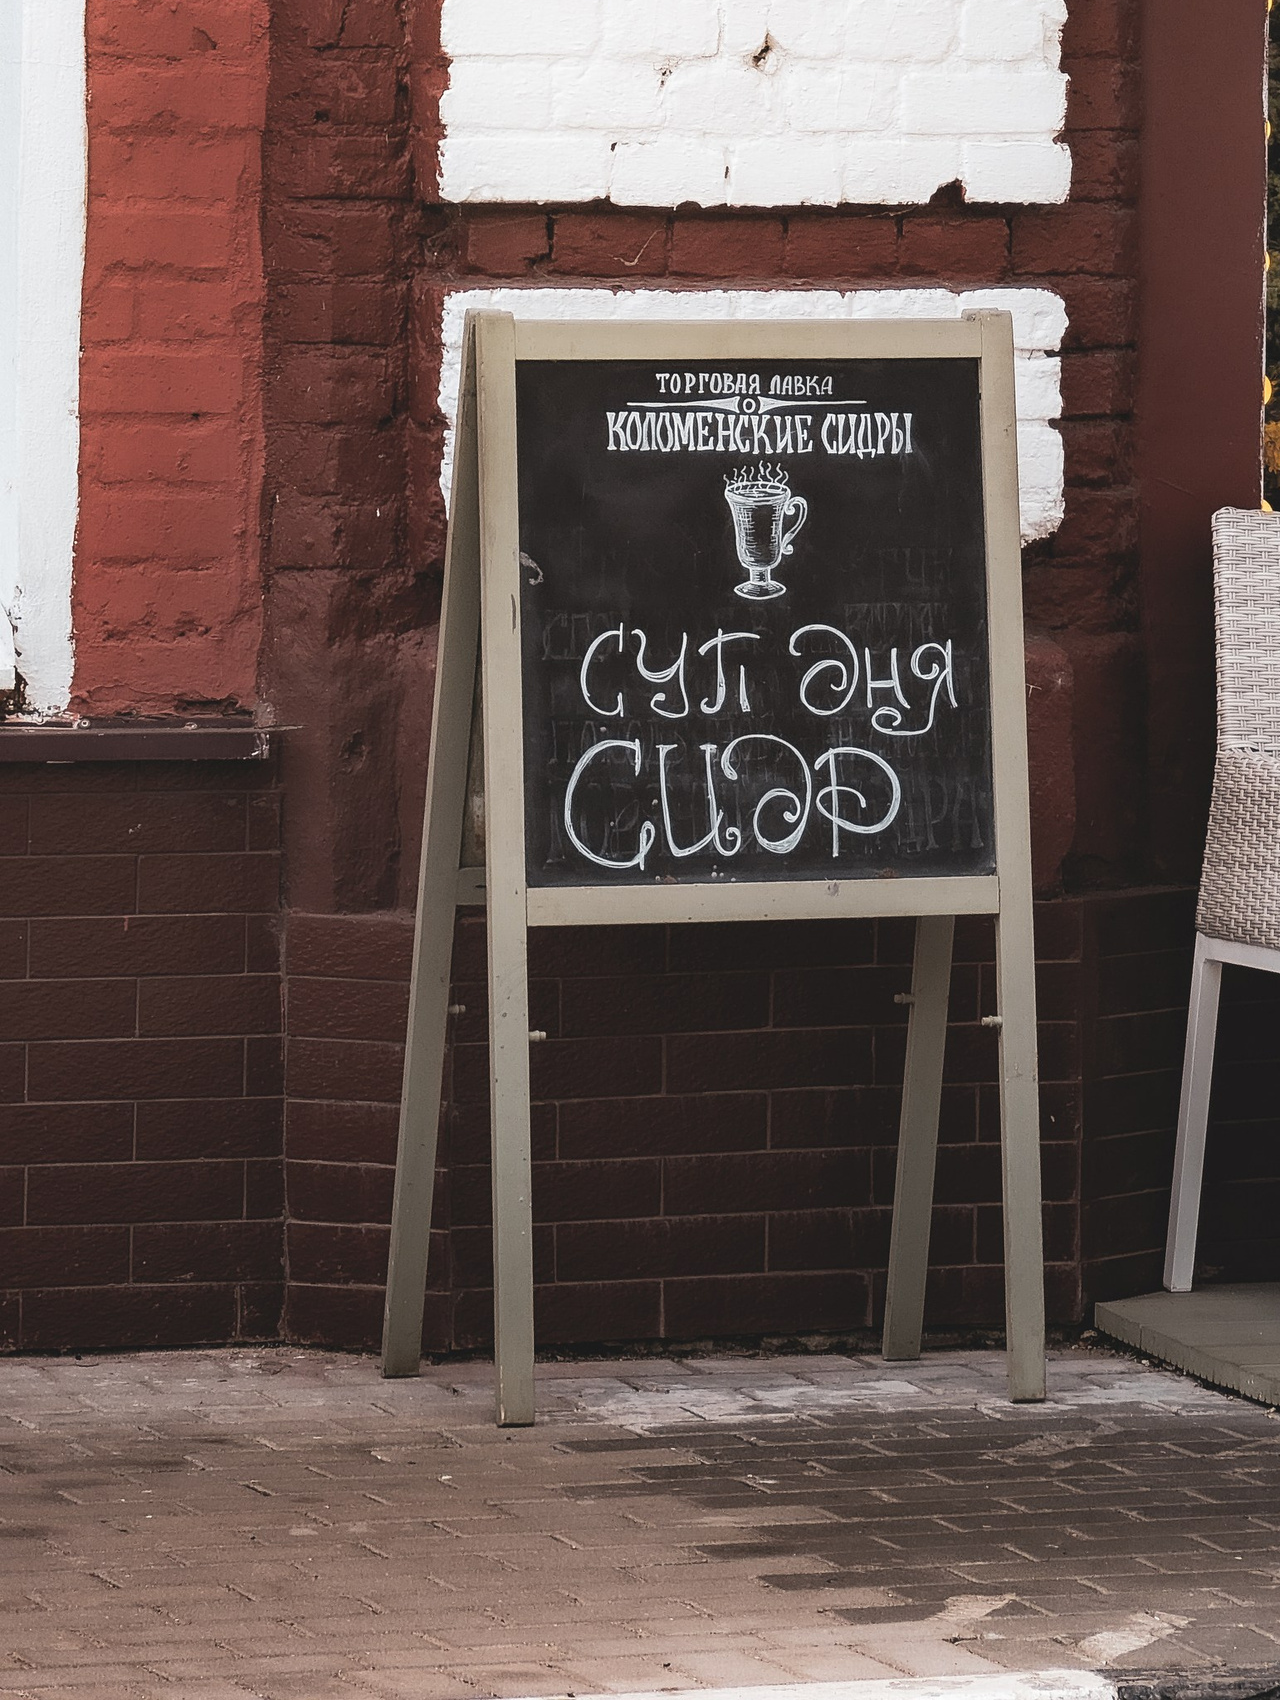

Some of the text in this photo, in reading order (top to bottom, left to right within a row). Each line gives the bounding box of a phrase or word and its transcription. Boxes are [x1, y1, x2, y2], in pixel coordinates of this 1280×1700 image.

[656, 373, 833, 396] ТОРГОВАЯ ЛАВКА
[606, 411, 913, 459] КОЛОМЕНСКИЕ СИДРЫ
